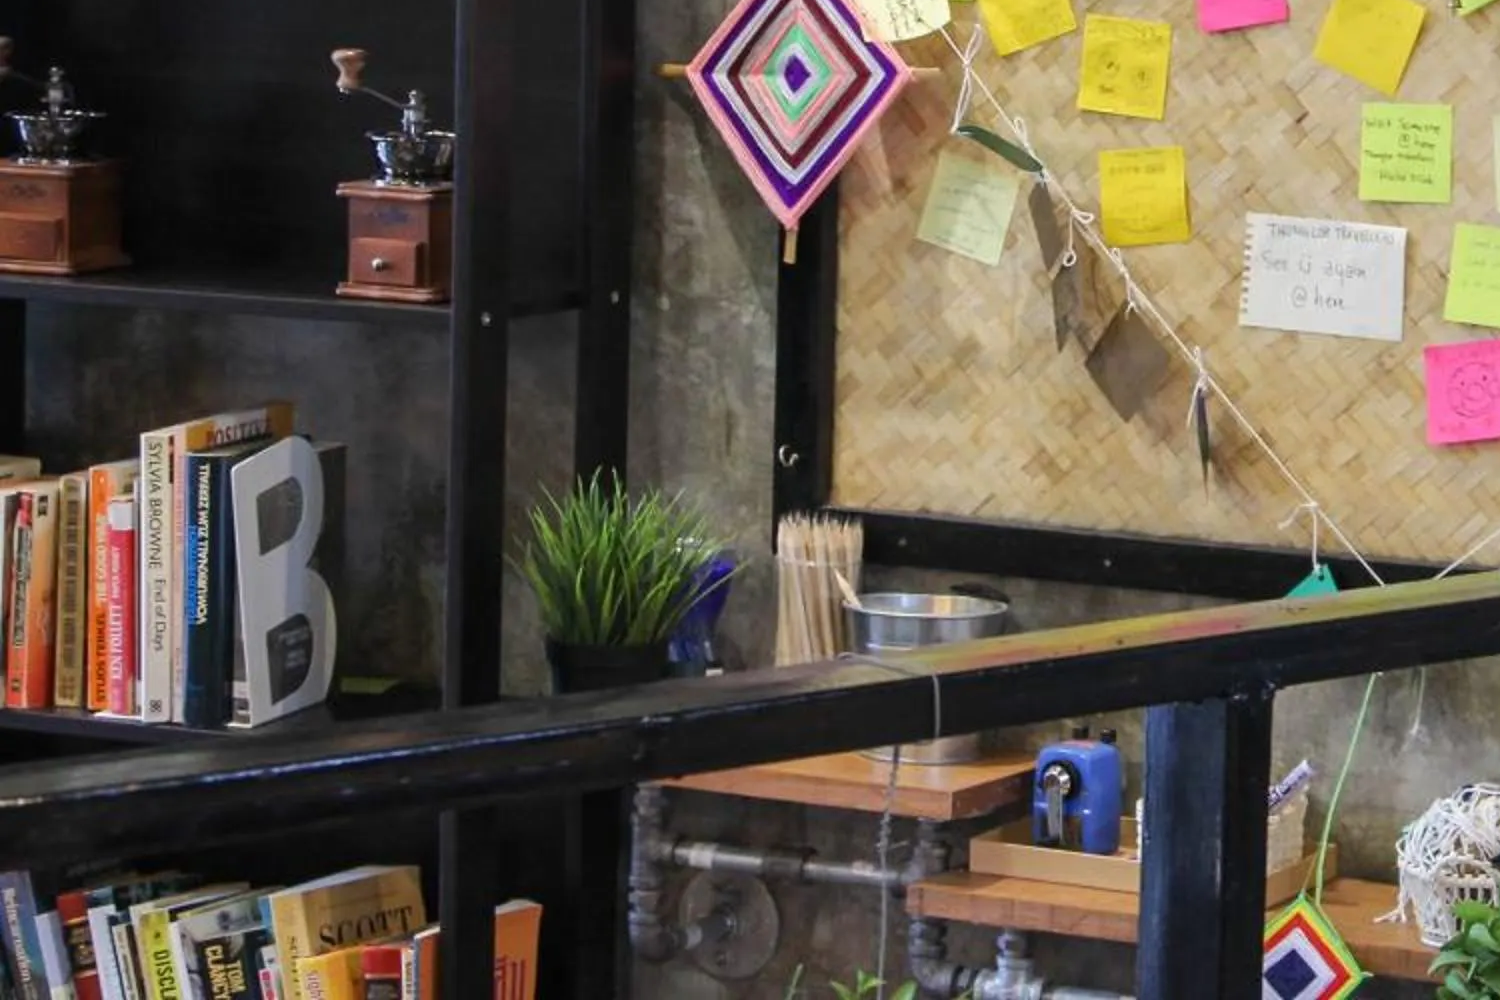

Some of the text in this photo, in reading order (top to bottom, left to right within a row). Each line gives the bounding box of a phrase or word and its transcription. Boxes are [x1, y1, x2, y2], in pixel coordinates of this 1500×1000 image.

[147, 442, 167, 652] SYLVIA BROWNE End of Days
[111, 603, 123, 654] FOLLETT
[319, 905, 413, 947] SCOTT
[227, 959, 247, 993] TOM
